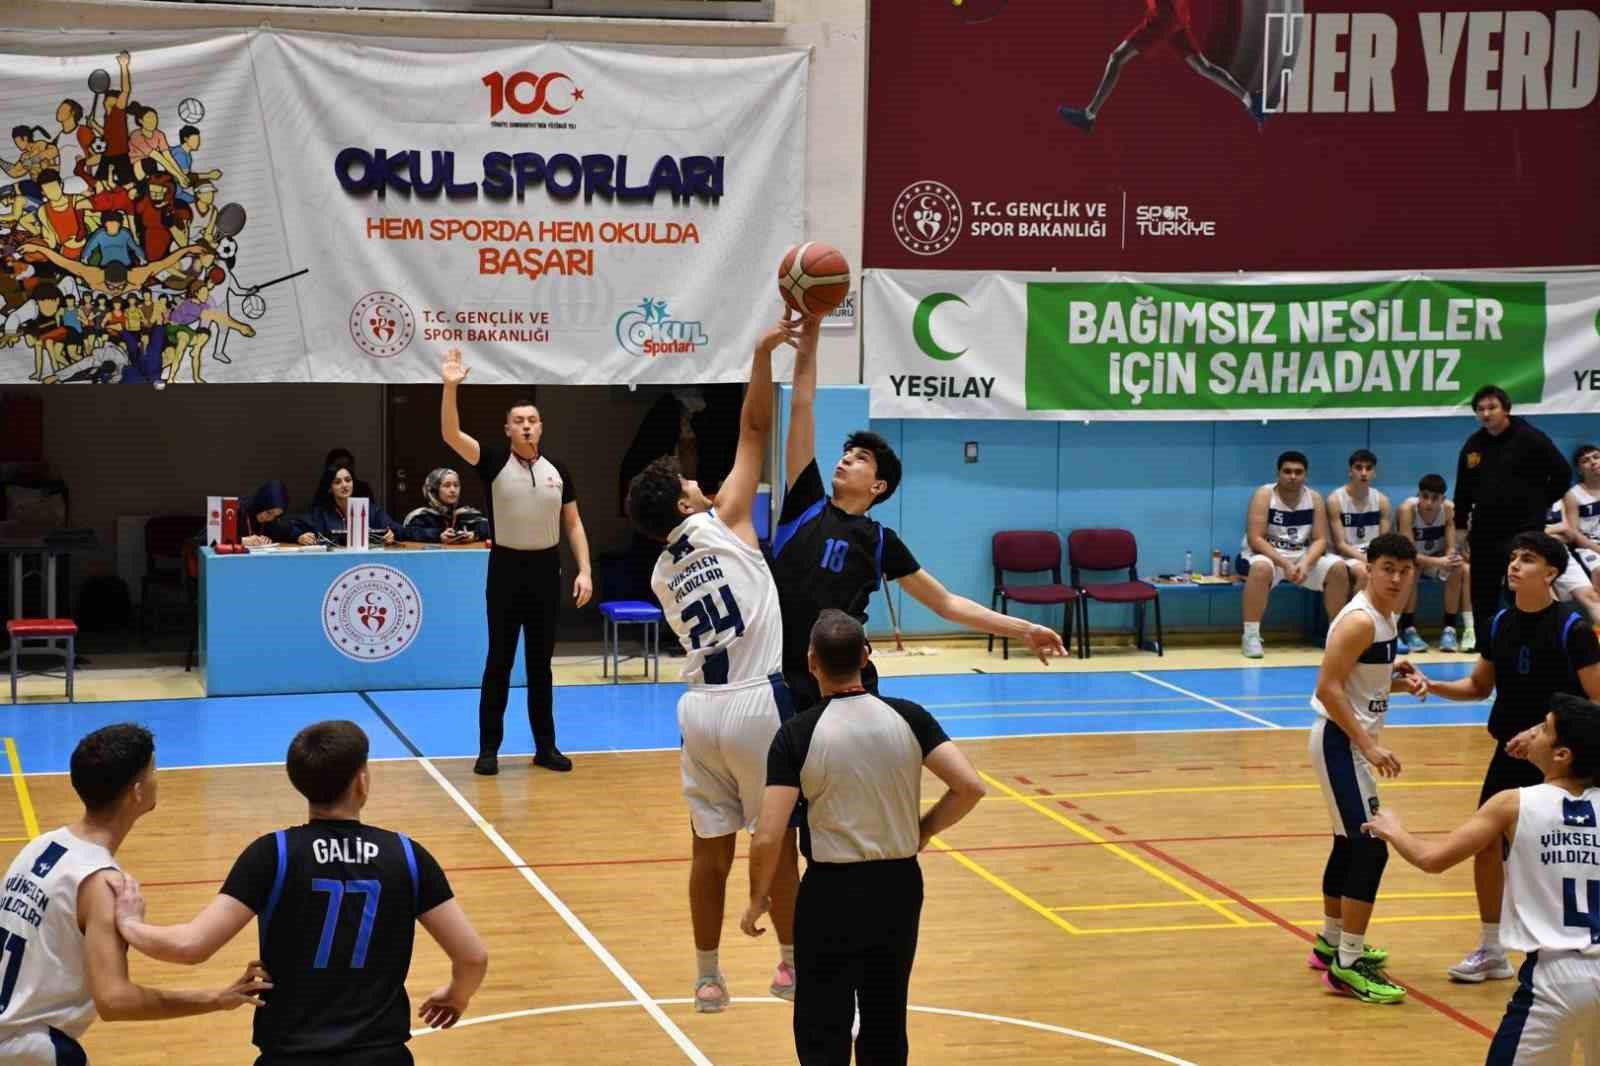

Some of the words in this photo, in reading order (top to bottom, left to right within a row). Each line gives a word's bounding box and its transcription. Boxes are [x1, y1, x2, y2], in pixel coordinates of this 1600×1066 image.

[1262, 13, 1398, 113] HER
[1418, 10, 1600, 112] YERD
[335, 147, 478, 201] OKUL
[482, 152, 725, 205] SPORLARI
[971, 202, 1001, 217] T.C.
[1006, 200, 1080, 221] GENÇLİK
[1085, 202, 1107, 217] VE
[1136, 205, 1188, 220] SPOR
[366, 217, 424, 240] HEM
[429, 219, 533, 242] SPORDA
[539, 220, 593, 243] HEM
[598, 221, 700, 244] OKULDA
[971, 222, 1014, 237] SPOR
[1018, 220, 1107, 237] BAKANLIĞI
[1136, 218, 1217, 236] TÜRKİYE
[478, 247, 594, 280] BAŞARI
[423, 310, 452, 324] T.C.
[455, 309, 525, 327] GENÇLİK
[529, 311, 550, 325] VE
[1068, 296, 1277, 344] BAĞIMSIZ
[423, 328, 463, 342] SPOR
[467, 326, 550, 343] BAKANLIĞI
[629, 320, 709, 347] OKUL
[1208, 348, 1460, 394] SAHADAYIZ
[1574, 369, 1600, 391] YE
[820, 537, 850, 573] 18
[681, 584, 746, 649] 24
[312, 837, 379, 865] GALİP
[1541, 830, 1600, 849] YÜKSEL
[1541, 850, 1600, 866] YILDIZL
[311, 878, 383, 968] 77
